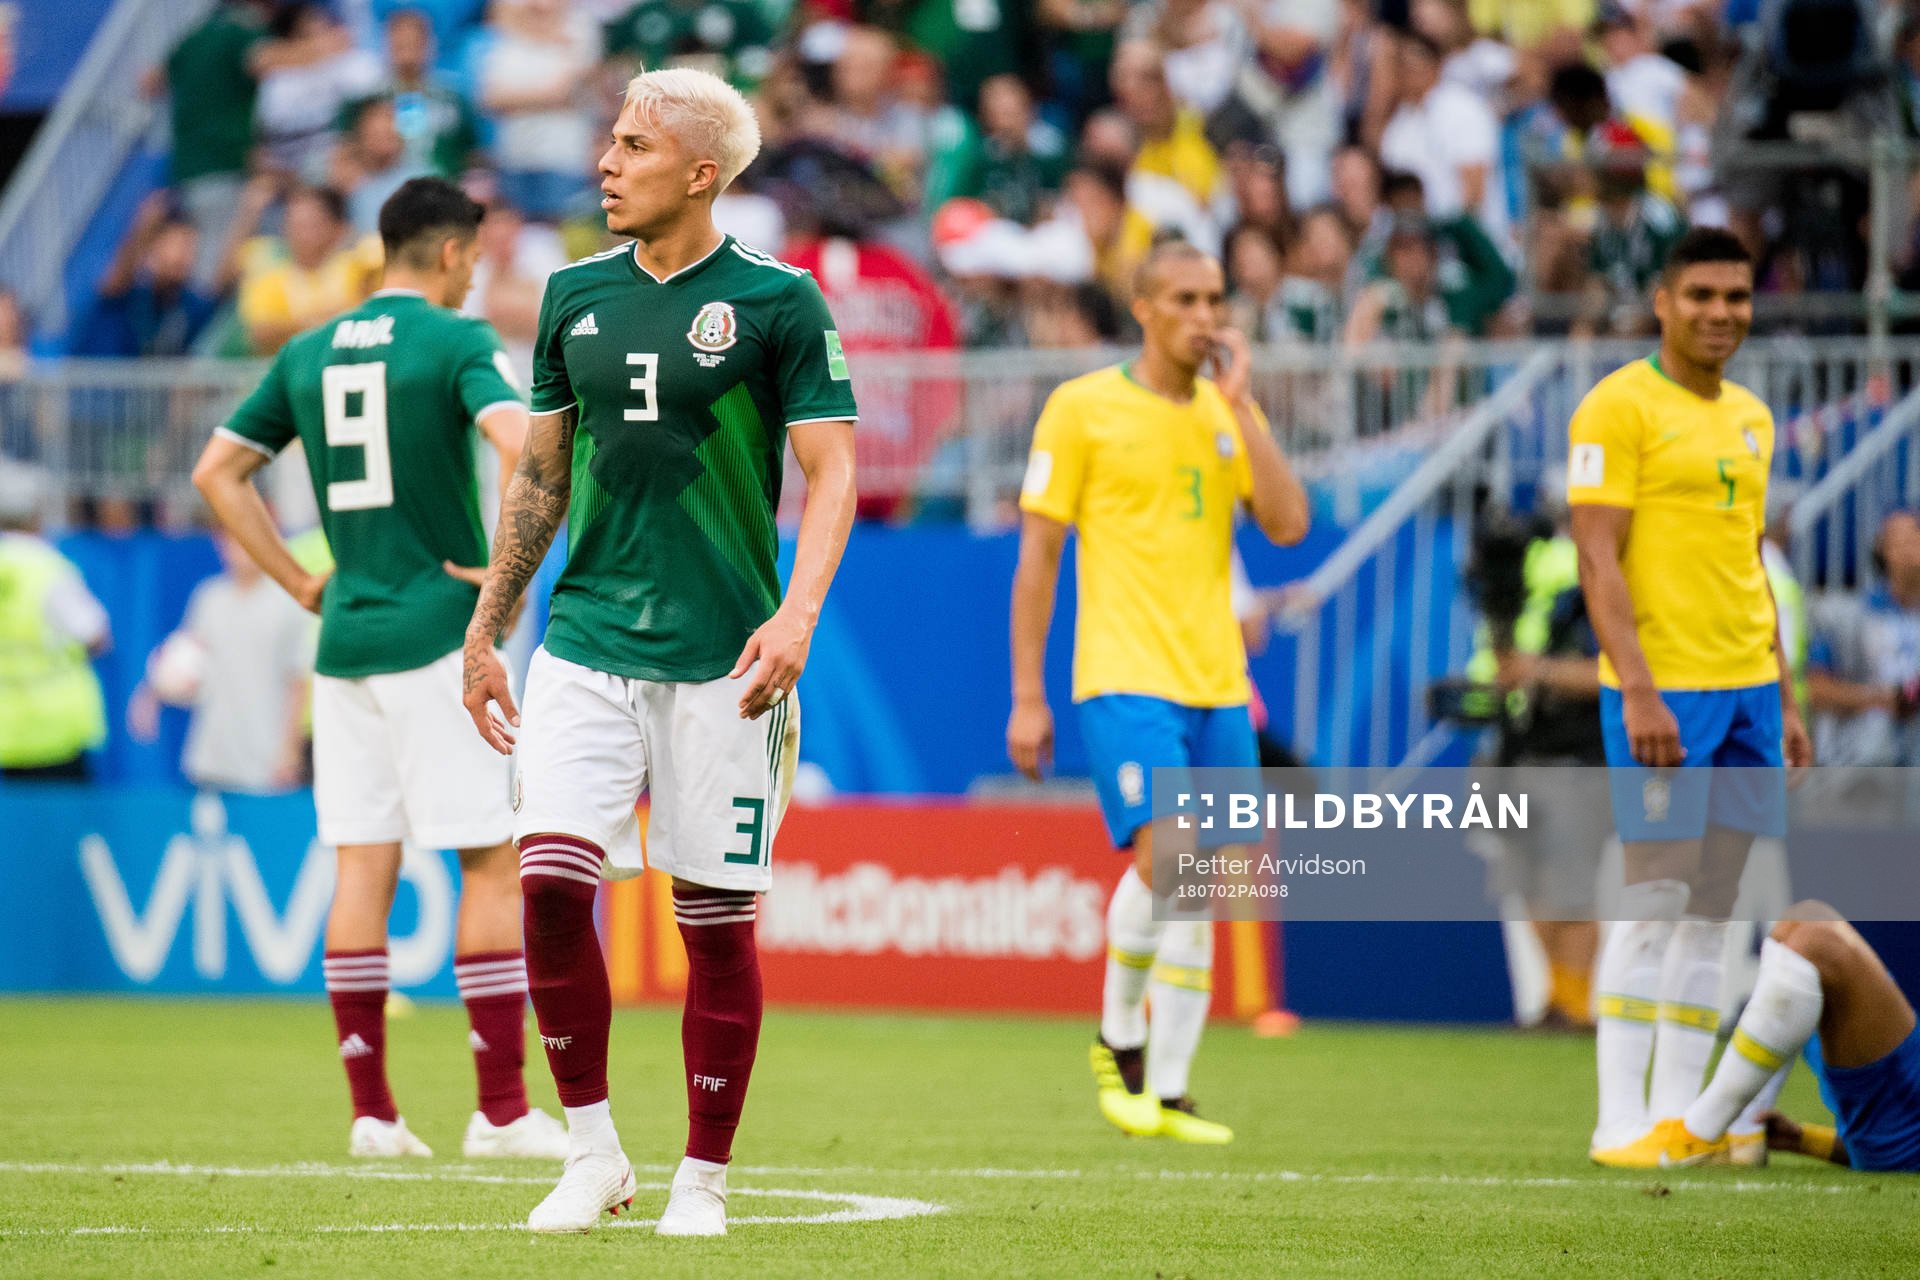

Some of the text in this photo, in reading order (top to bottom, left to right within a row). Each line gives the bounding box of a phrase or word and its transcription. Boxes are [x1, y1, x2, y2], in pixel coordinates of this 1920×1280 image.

[624, 353, 659, 421] 3
[322, 361, 394, 511] 9
[1178, 465, 1203, 519] 3
[1716, 458, 1735, 509] 5
[724, 797, 765, 865] 3
[540, 1034, 573, 1050] FMF
[693, 1074, 727, 1092] FMF
